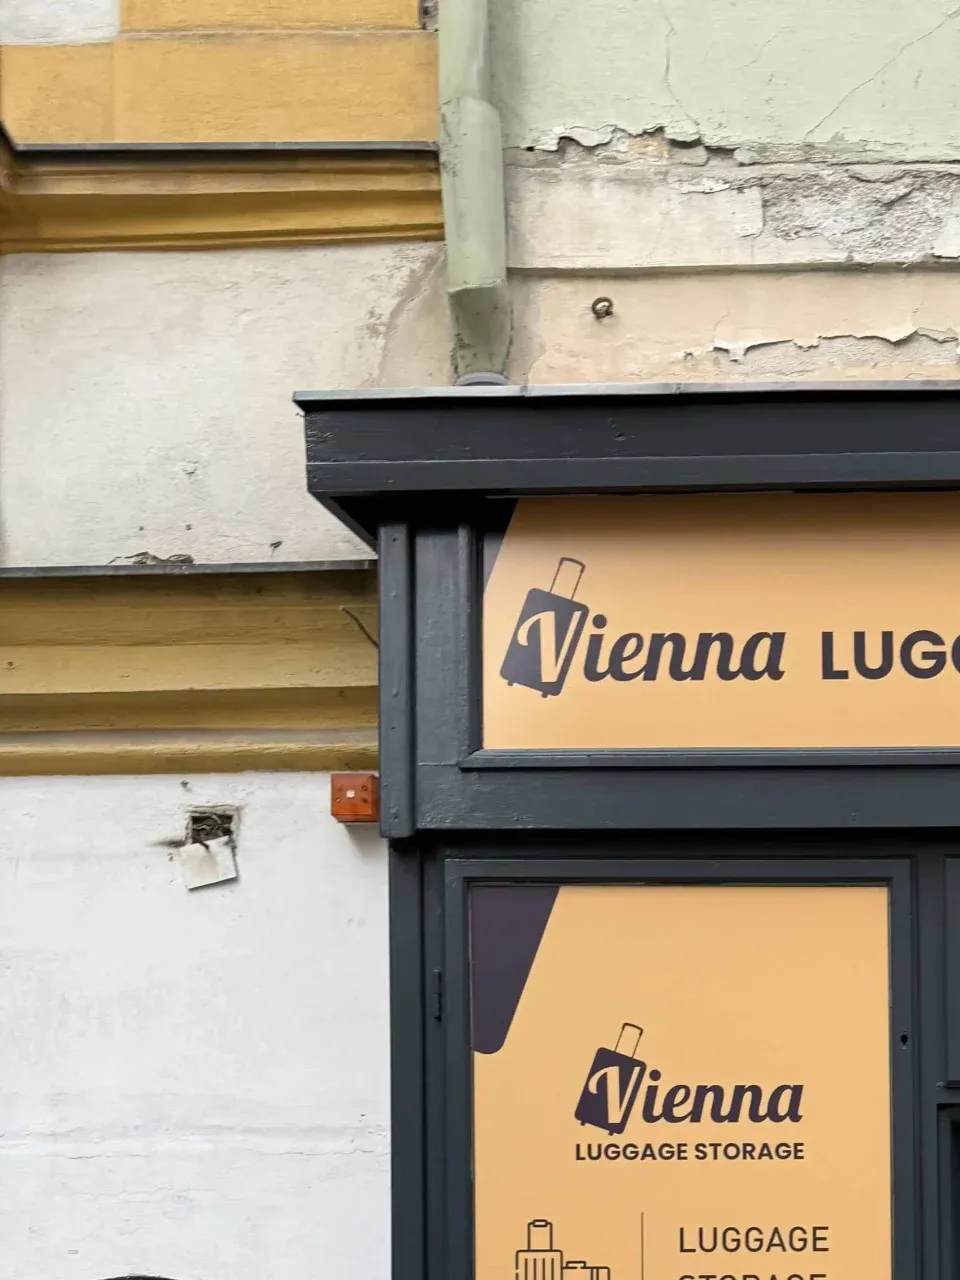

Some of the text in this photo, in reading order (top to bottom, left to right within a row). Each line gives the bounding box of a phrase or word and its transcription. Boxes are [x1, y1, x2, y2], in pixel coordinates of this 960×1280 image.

[516, 610, 787, 683] Vienna
[587, 1064, 804, 1124] Vienna
[574, 1142, 805, 1161] LUGGAGE STORAGE
[678, 1226, 830, 1253] LUGGAGE
